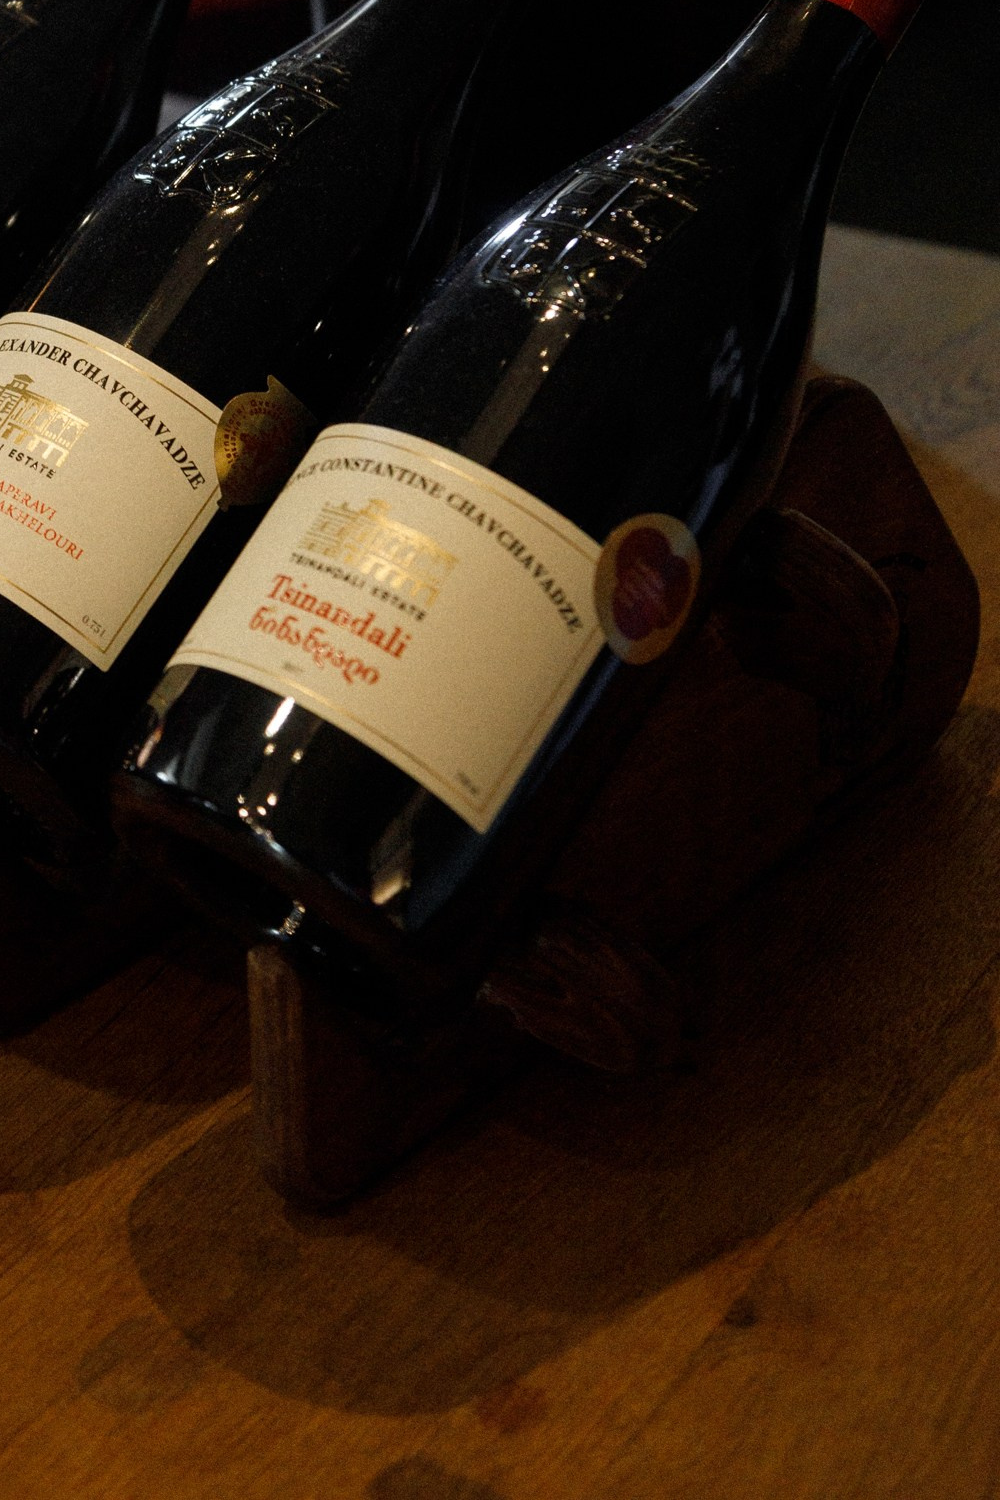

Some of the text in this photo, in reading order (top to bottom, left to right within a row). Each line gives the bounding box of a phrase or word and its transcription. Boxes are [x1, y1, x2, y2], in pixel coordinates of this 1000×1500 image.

[8, 449, 56, 479] ESTATE
[73, 358, 206, 491] CHAVCHAVADZE
[320, 457, 446, 499] CONSTANTINE
[446, 491, 583, 633] CHAVCHAVADZE
[267, 574, 412, 659] Tsinandali
